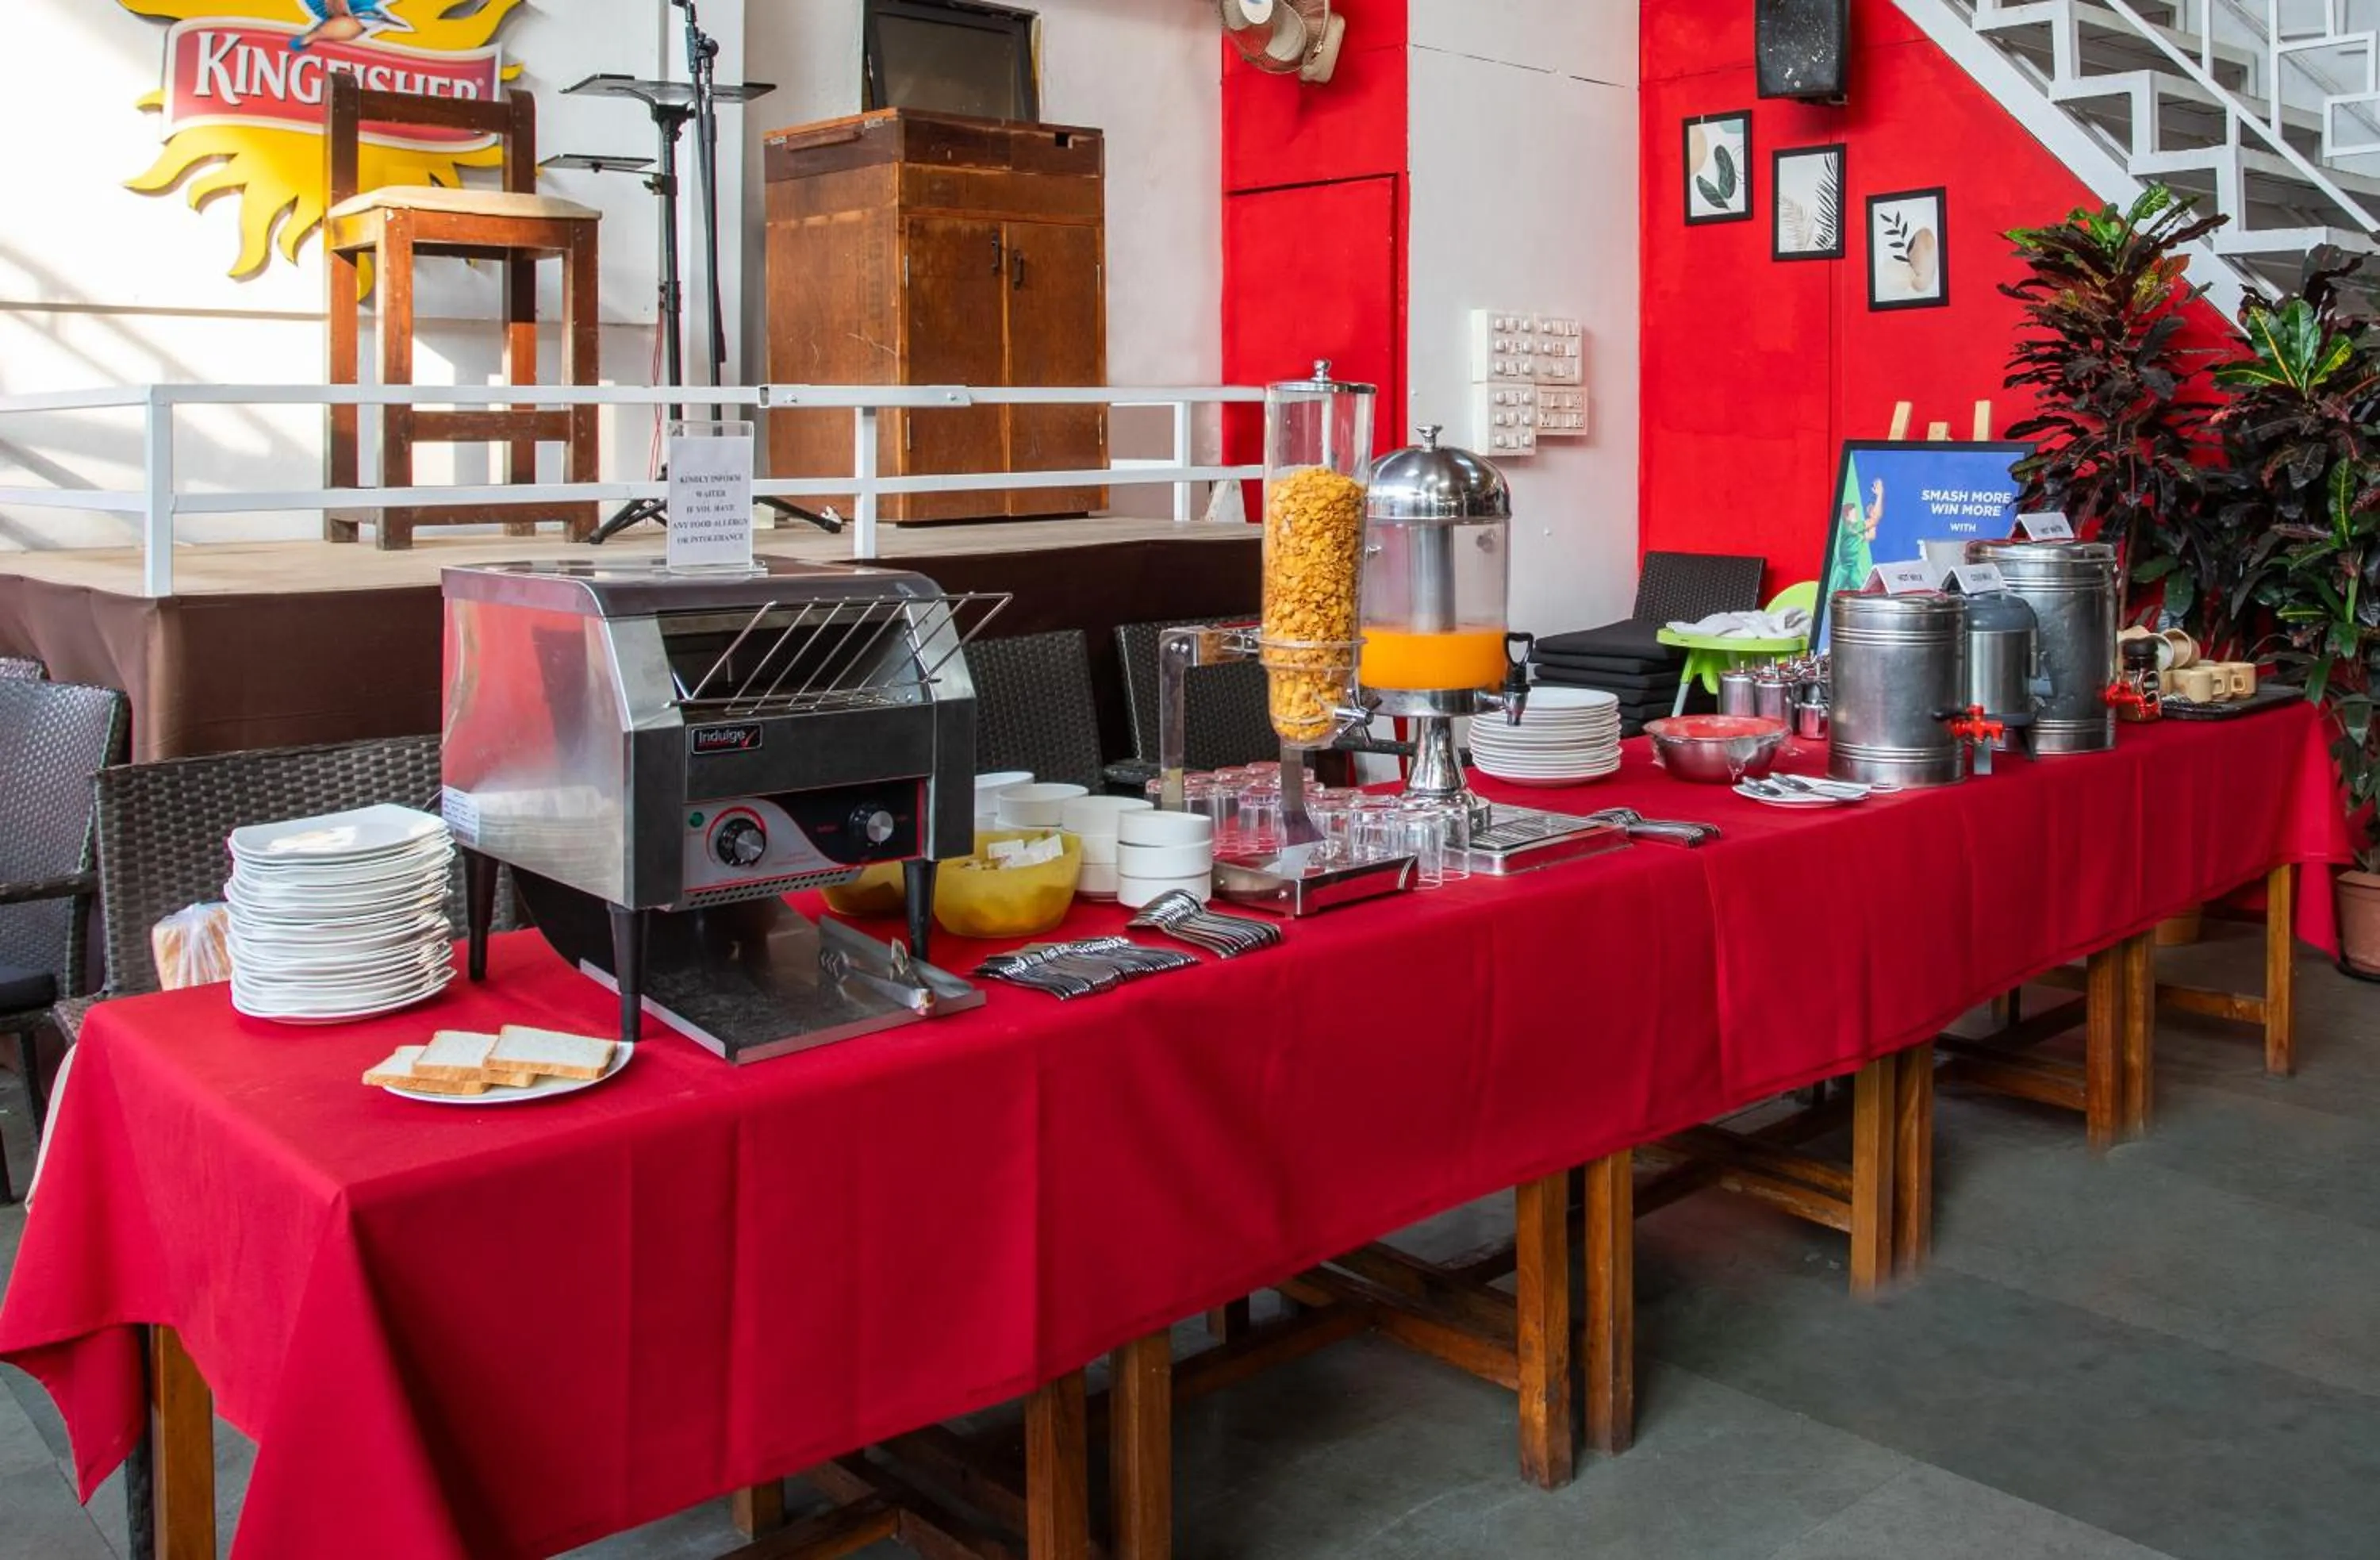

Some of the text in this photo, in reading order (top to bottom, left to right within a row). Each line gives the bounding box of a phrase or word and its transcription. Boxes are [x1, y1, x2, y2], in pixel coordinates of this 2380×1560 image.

[194, 31, 478, 106] KINGSH
[680, 474, 742, 483] KINDLY INFORM
[695, 490, 727, 498] WAITER
[1921, 490, 2013, 504] SMASH MORE
[696, 505, 712, 513] YOU
[1930, 502, 2002, 517] WIN MORE
[689, 520, 712, 528] FOOD
[714, 518, 749, 527] ALLERGY
[1949, 522, 1977, 532] WITH
[690, 532, 745, 544] INTOLERANCE
[698, 728, 746, 743] Indulge
